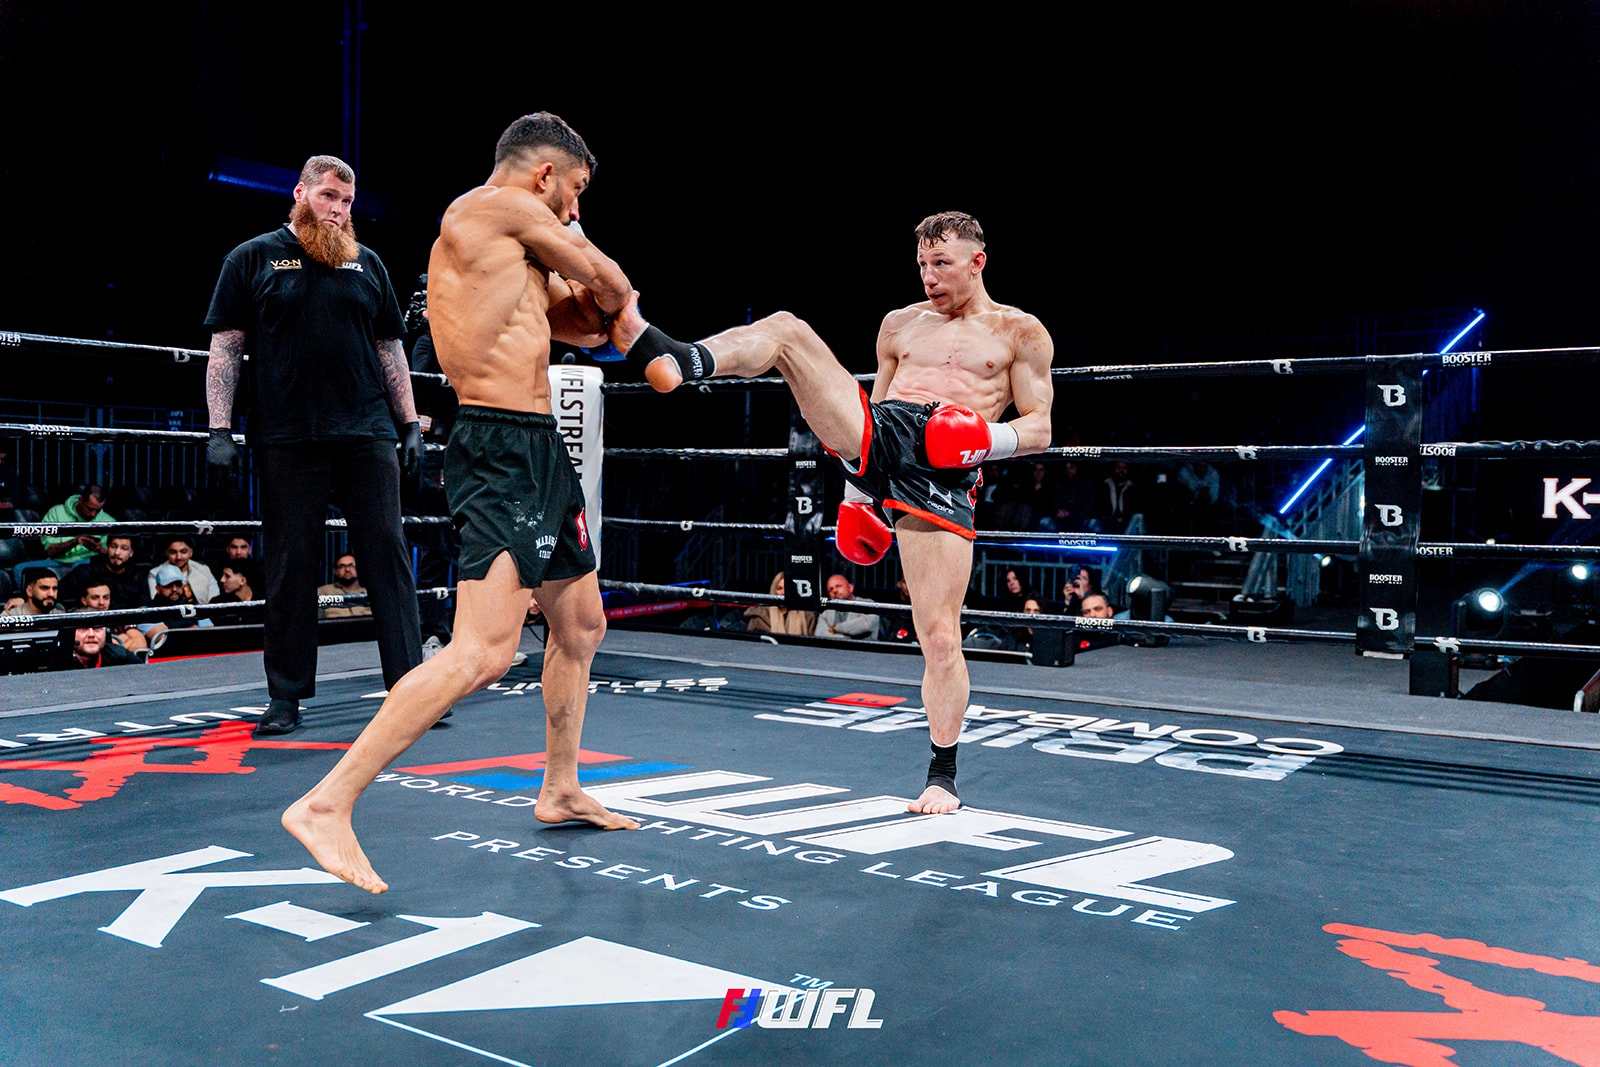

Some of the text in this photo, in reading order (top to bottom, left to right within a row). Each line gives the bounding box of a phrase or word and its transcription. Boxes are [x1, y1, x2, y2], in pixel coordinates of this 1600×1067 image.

[1442, 352, 1492, 364] BOOSTER
[559, 368, 585, 480] WFLSTREA
[1420, 445, 1456, 457] BOOST
[13, 526, 58, 535] BOOSTER
[1416, 546, 1453, 555] OSTER
[1369, 574, 1403, 582] BOOSTER
[1075, 616, 1114, 626] BOOSTER
[754, 702, 1317, 781] PRIME
[375, 771, 538, 807] WORLD
[859, 861, 1196, 932] LEAGUE
[431, 830, 793, 911] PRESENTS
[0, 845, 541, 1001] K-1
